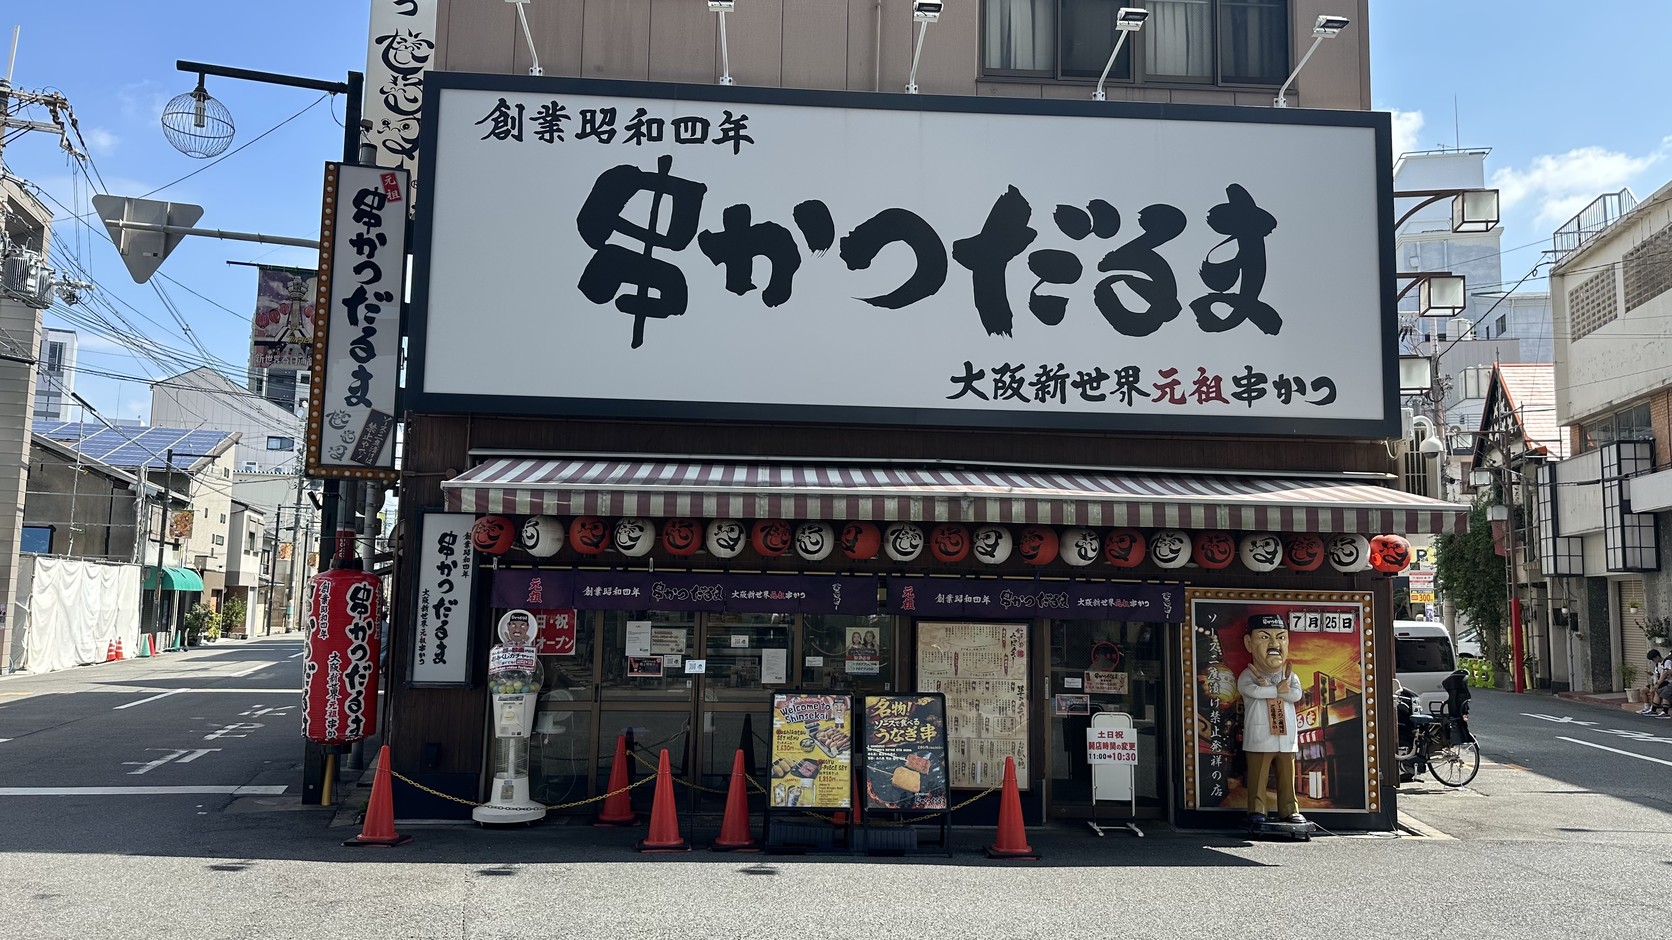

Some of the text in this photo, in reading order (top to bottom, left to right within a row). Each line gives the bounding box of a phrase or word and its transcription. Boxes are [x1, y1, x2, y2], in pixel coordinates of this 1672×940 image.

[475, 98, 755, 154] 創業昭和四年
[577, 154, 1283, 349] 串かつだるま
[342, 186, 394, 408] 串かつだるま
[947, 361, 1337, 407] 大阪新世界元祖串かつ
[461, 531, 473, 579] 創業昭和四年
[432, 530, 459, 665] 串かつだるま
[528, 577, 543, 604] 元祖
[582, 585, 642, 598] 創業昭和四年
[651, 581, 724, 602] 串かつだるま
[731, 589, 806, 600] 大阪新世界元祖串かつ
[901, 586, 916, 611] 元祖
[934, 594, 992, 605] 創業昭和四年
[999, 588, 1070, 610] 串かつだるま
[319, 580, 331, 639] 創業昭和四年
[1077, 597, 1151, 608] 大阪新世界元祖串かつ
[418, 588, 430, 666] 大阪新世界元祖串かつ
[1292, 615, 1353, 630] 7月25日
[536, 635, 574, 650] オープン
[344, 582, 374, 738] 串かつだるま
[779, 702, 831, 716] Welcome to
[870, 697, 913, 718] 名物!
[1207, 613, 1223, 798] ソース二度漬け禁止発祥の店
[785, 711, 828, 724] Shinsekai
[874, 718, 920, 729] ソースで食べる
[875, 724, 938, 745] うなぎ串
[1097, 730, 1124, 739] 土日祝
[1088, 741, 1136, 751] 開店時間の変更
[1112, 752, 1136, 761] 10:30
